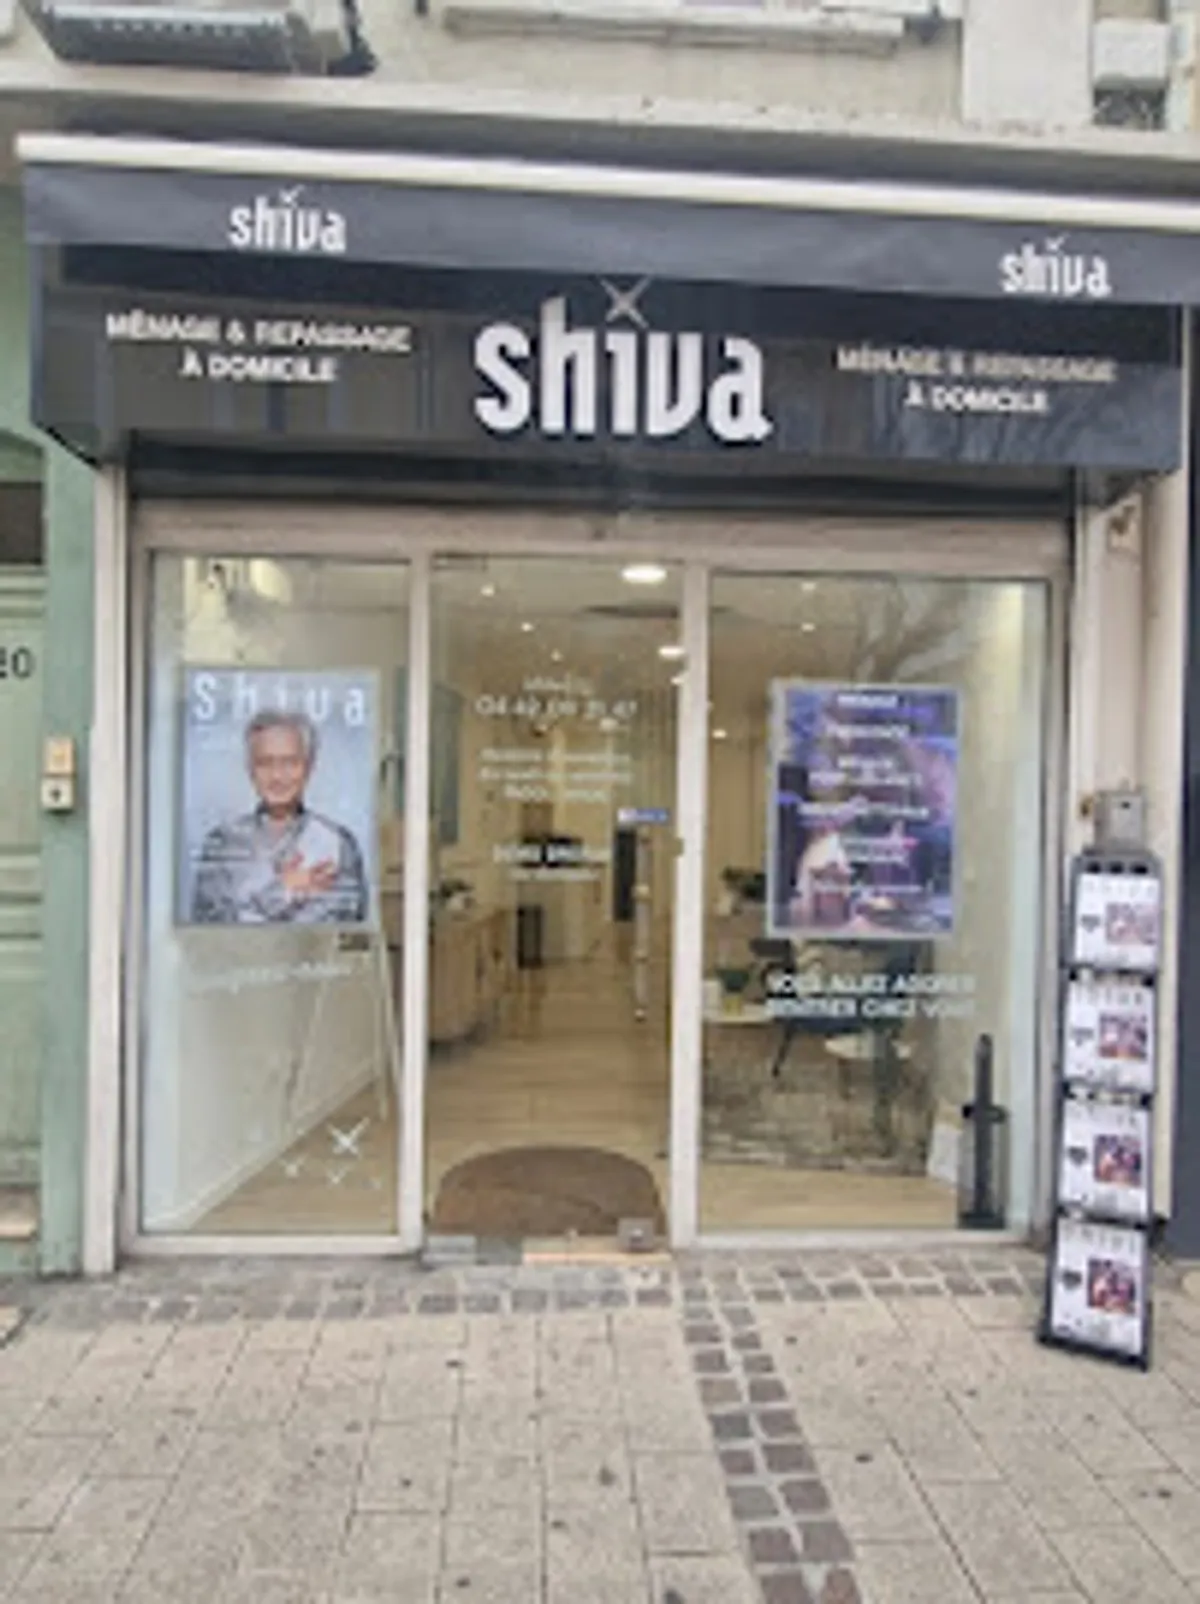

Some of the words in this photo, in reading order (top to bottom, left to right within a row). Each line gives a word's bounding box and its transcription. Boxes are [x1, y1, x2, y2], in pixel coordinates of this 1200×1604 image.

[228, 188, 348, 253] shiva
[999, 238, 1112, 299] shiva
[106, 311, 221, 343] MÉNAGE
[226, 319, 246, 345] &
[254, 320, 413, 354] REPASSAGE
[207, 356, 339, 383] DOMICILE
[474, 277, 774, 443] shiva
[930, 385, 1050, 414] DOMICILE
